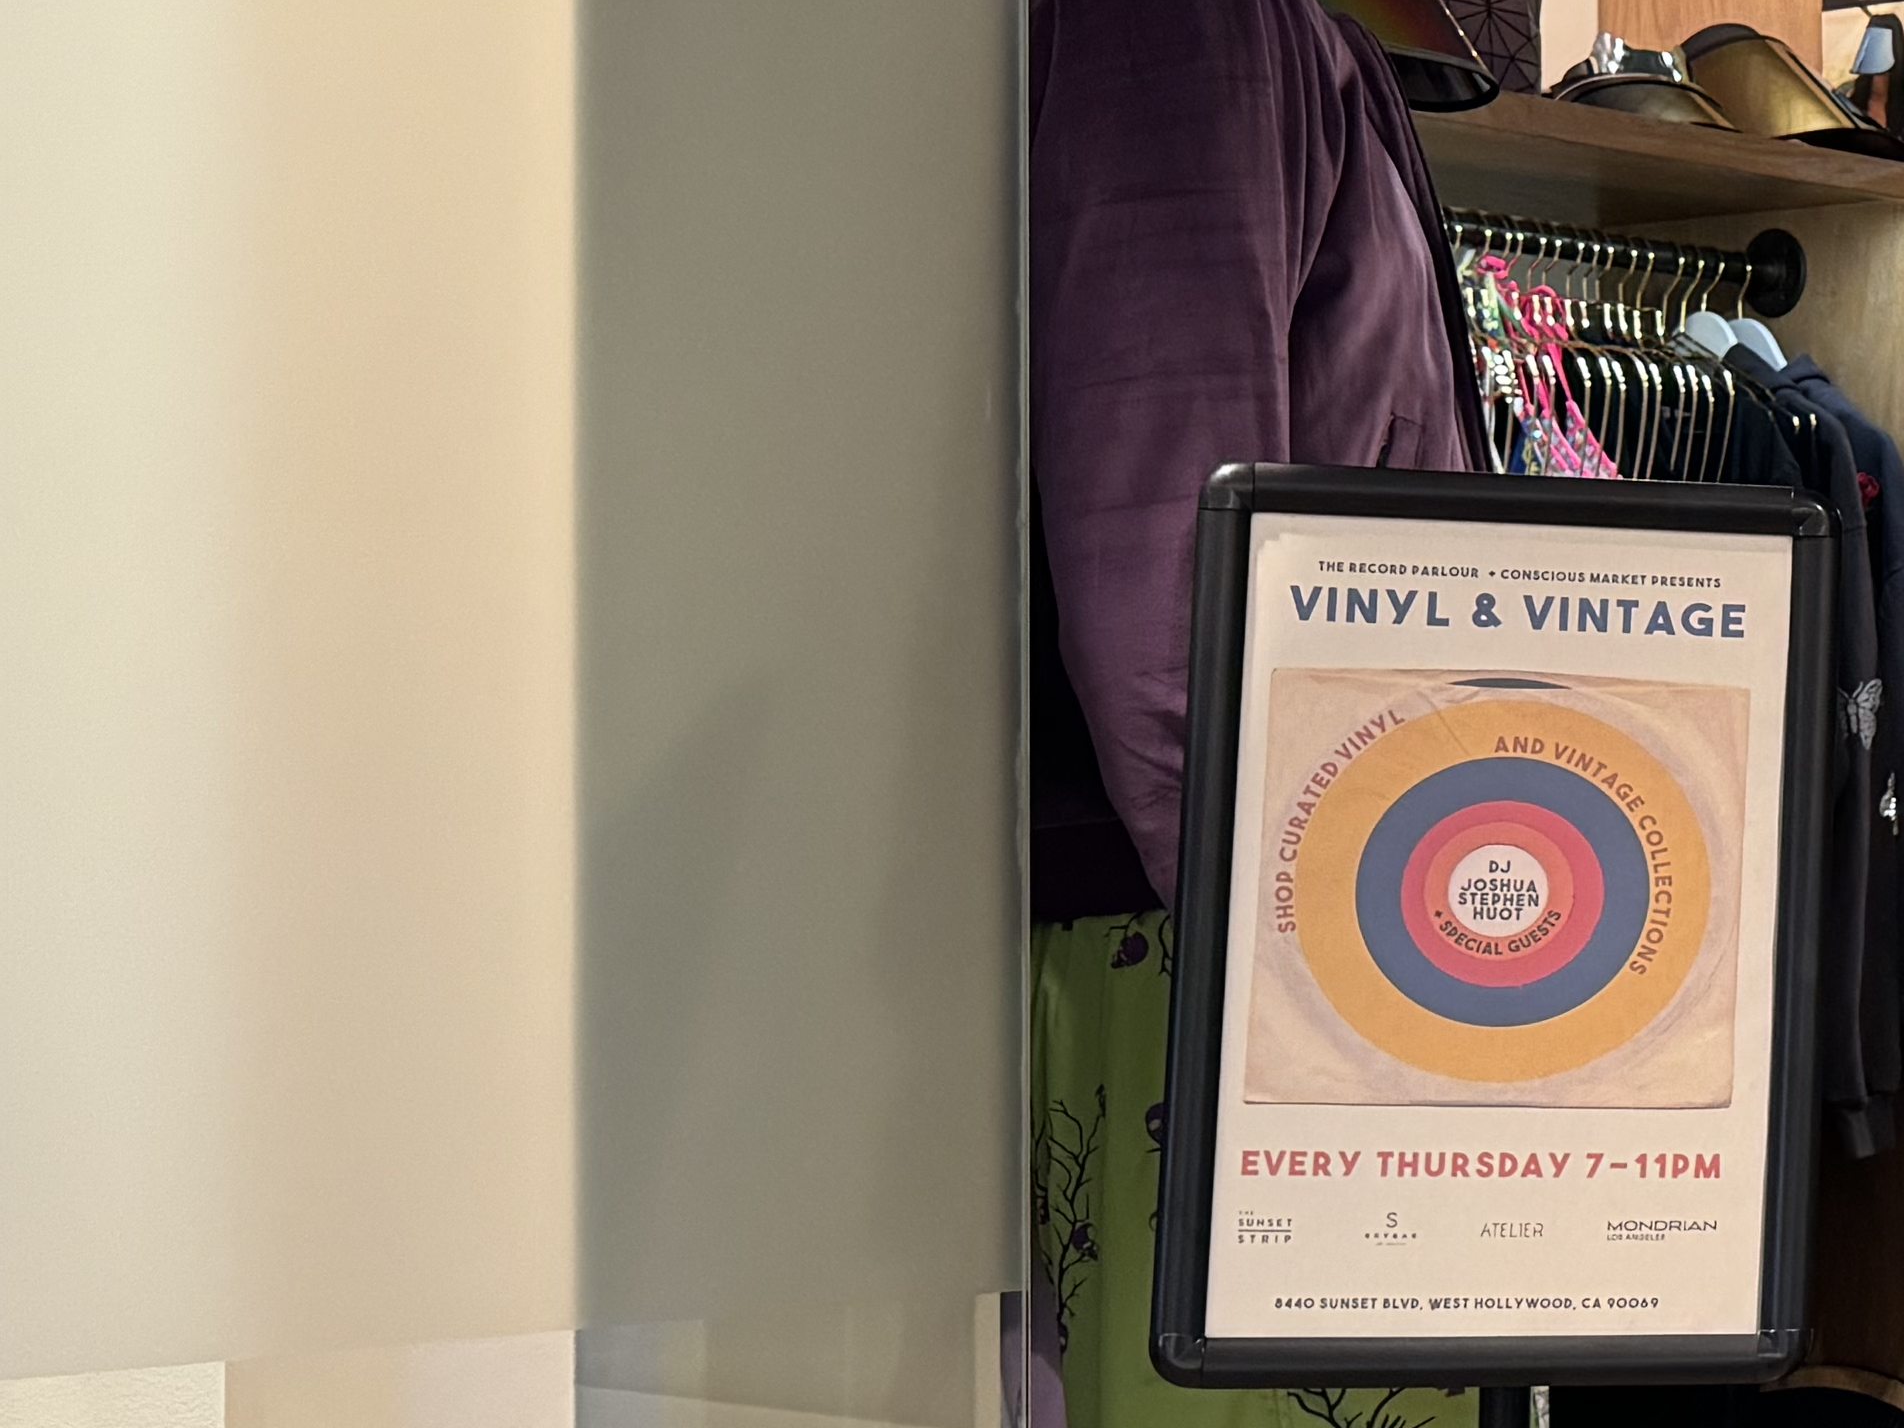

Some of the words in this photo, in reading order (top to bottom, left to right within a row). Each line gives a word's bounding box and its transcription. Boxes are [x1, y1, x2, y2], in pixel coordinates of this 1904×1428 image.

[1318, 561, 1344, 572] THE
[1349, 562, 1407, 575] RECORD
[1411, 565, 1479, 578] PARLOUR
[1500, 568, 1586, 583] CONSCIOUS
[1589, 572, 1647, 586] MARKET
[1651, 575, 1721, 588] PRESENTS
[1290, 585, 1450, 627] VINYL
[1472, 592, 1502, 628] &
[1523, 595, 1747, 638] VINTAGE
[1334, 709, 1406, 761] VINYL
[1279, 757, 1339, 862] CURATED
[1494, 736, 1546, 756] AND
[1555, 743, 1647, 814] VINTAGE
[1629, 815, 1673, 976] COLLECTIONS
[1489, 860, 1511, 873] DJ
[1460, 878, 1537, 893] JOSHUA
[1275, 870, 1297, 934] SHOP
[1458, 892, 1539, 907] STEPHEN
[1473, 907, 1524, 921] HUOT
[1439, 921, 1503, 956] SPECIAL
[1507, 910, 1562, 953] GUESTS
[1241, 1149, 1361, 1177] EVERY
[1377, 1151, 1572, 1178] THURSDAY
[1238, 1218, 1293, 1227] SUNSET
[1386, 1212, 1398, 1228] S
[1607, 1220, 1717, 1232] MONDRIAN
[1480, 1222, 1544, 1239] ATELIER
[1238, 1234, 1292, 1244] STRIP
[1274, 1297, 1315, 1310] 8440
[1319, 1298, 1378, 1310] SUNSET
[1382, 1298, 1423, 1311] BLVD,
[1428, 1298, 1469, 1310] WEST
[1474, 1298, 1577, 1311] HOLLYWOOD,
[1581, 1298, 1602, 1310] CA
[1606, 1298, 1660, 1310] 90069
